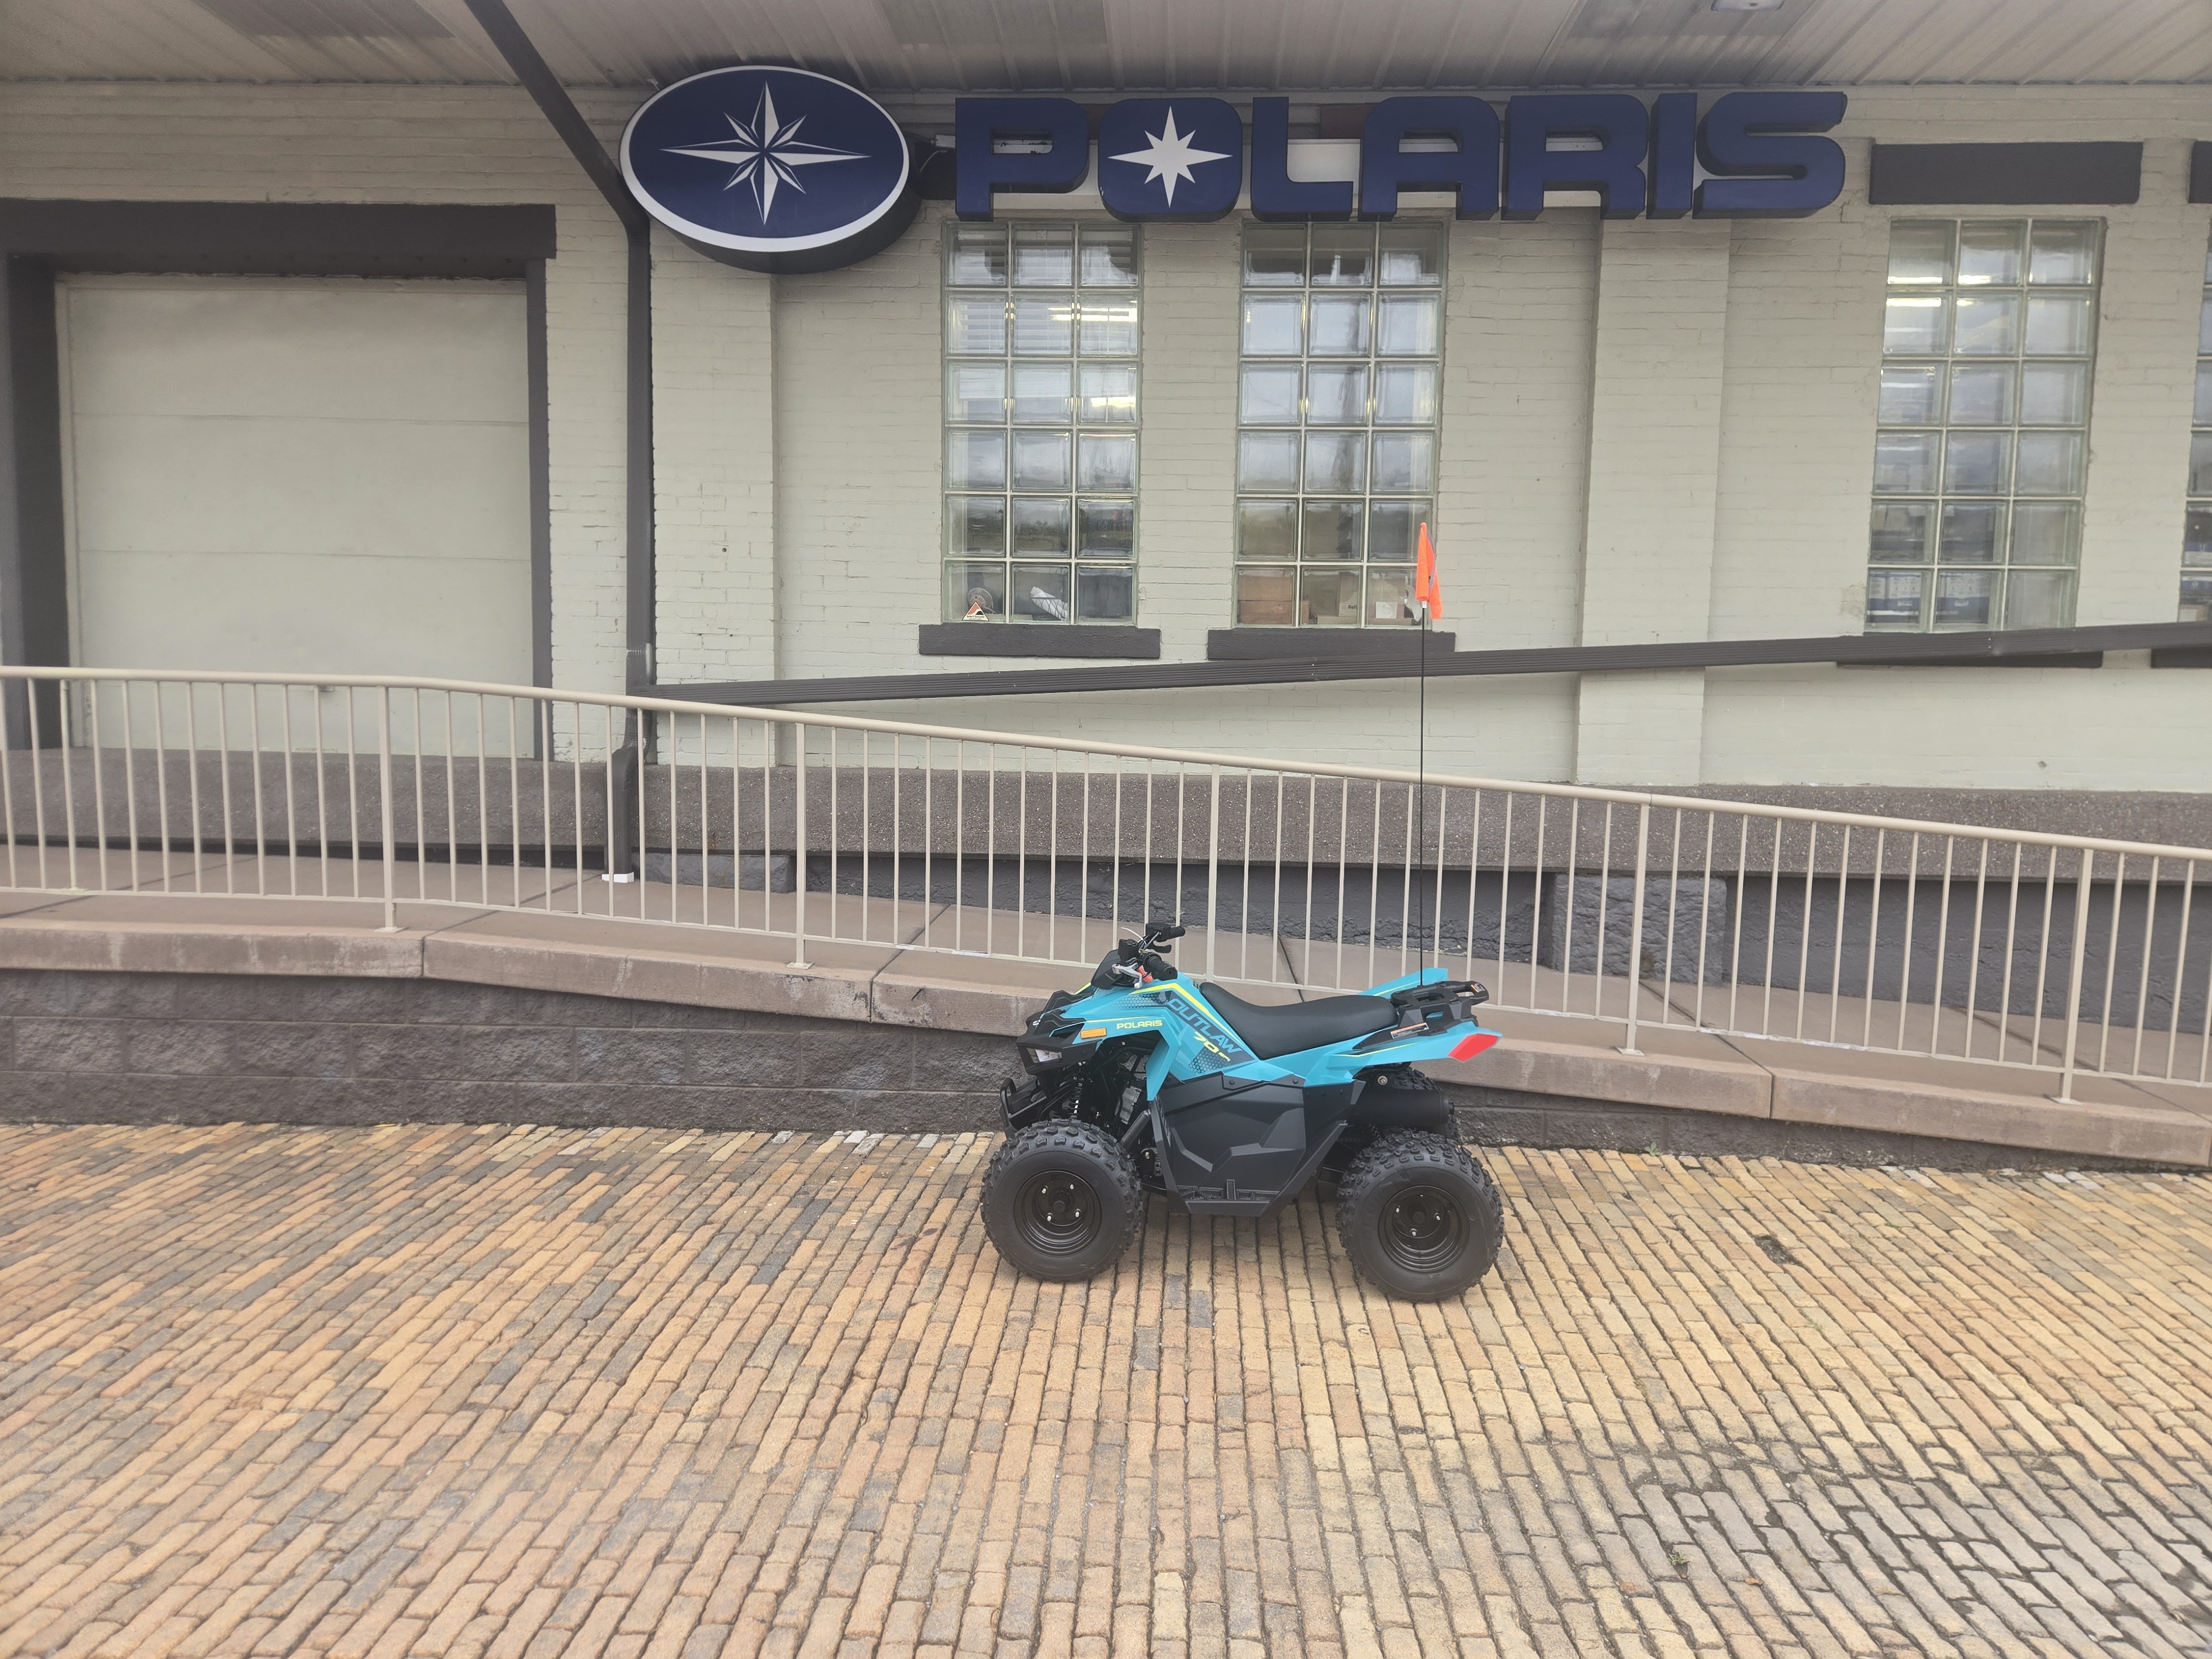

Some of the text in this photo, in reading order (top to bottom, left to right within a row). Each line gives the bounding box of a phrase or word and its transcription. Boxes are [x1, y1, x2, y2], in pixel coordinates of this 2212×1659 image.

[954, 90, 1848, 222] POLARIS
[1117, 1020, 1162, 1030] POLARIS
[1167, 998, 1243, 1053] OUTLAW
[1193, 1031, 1220, 1053] 70
